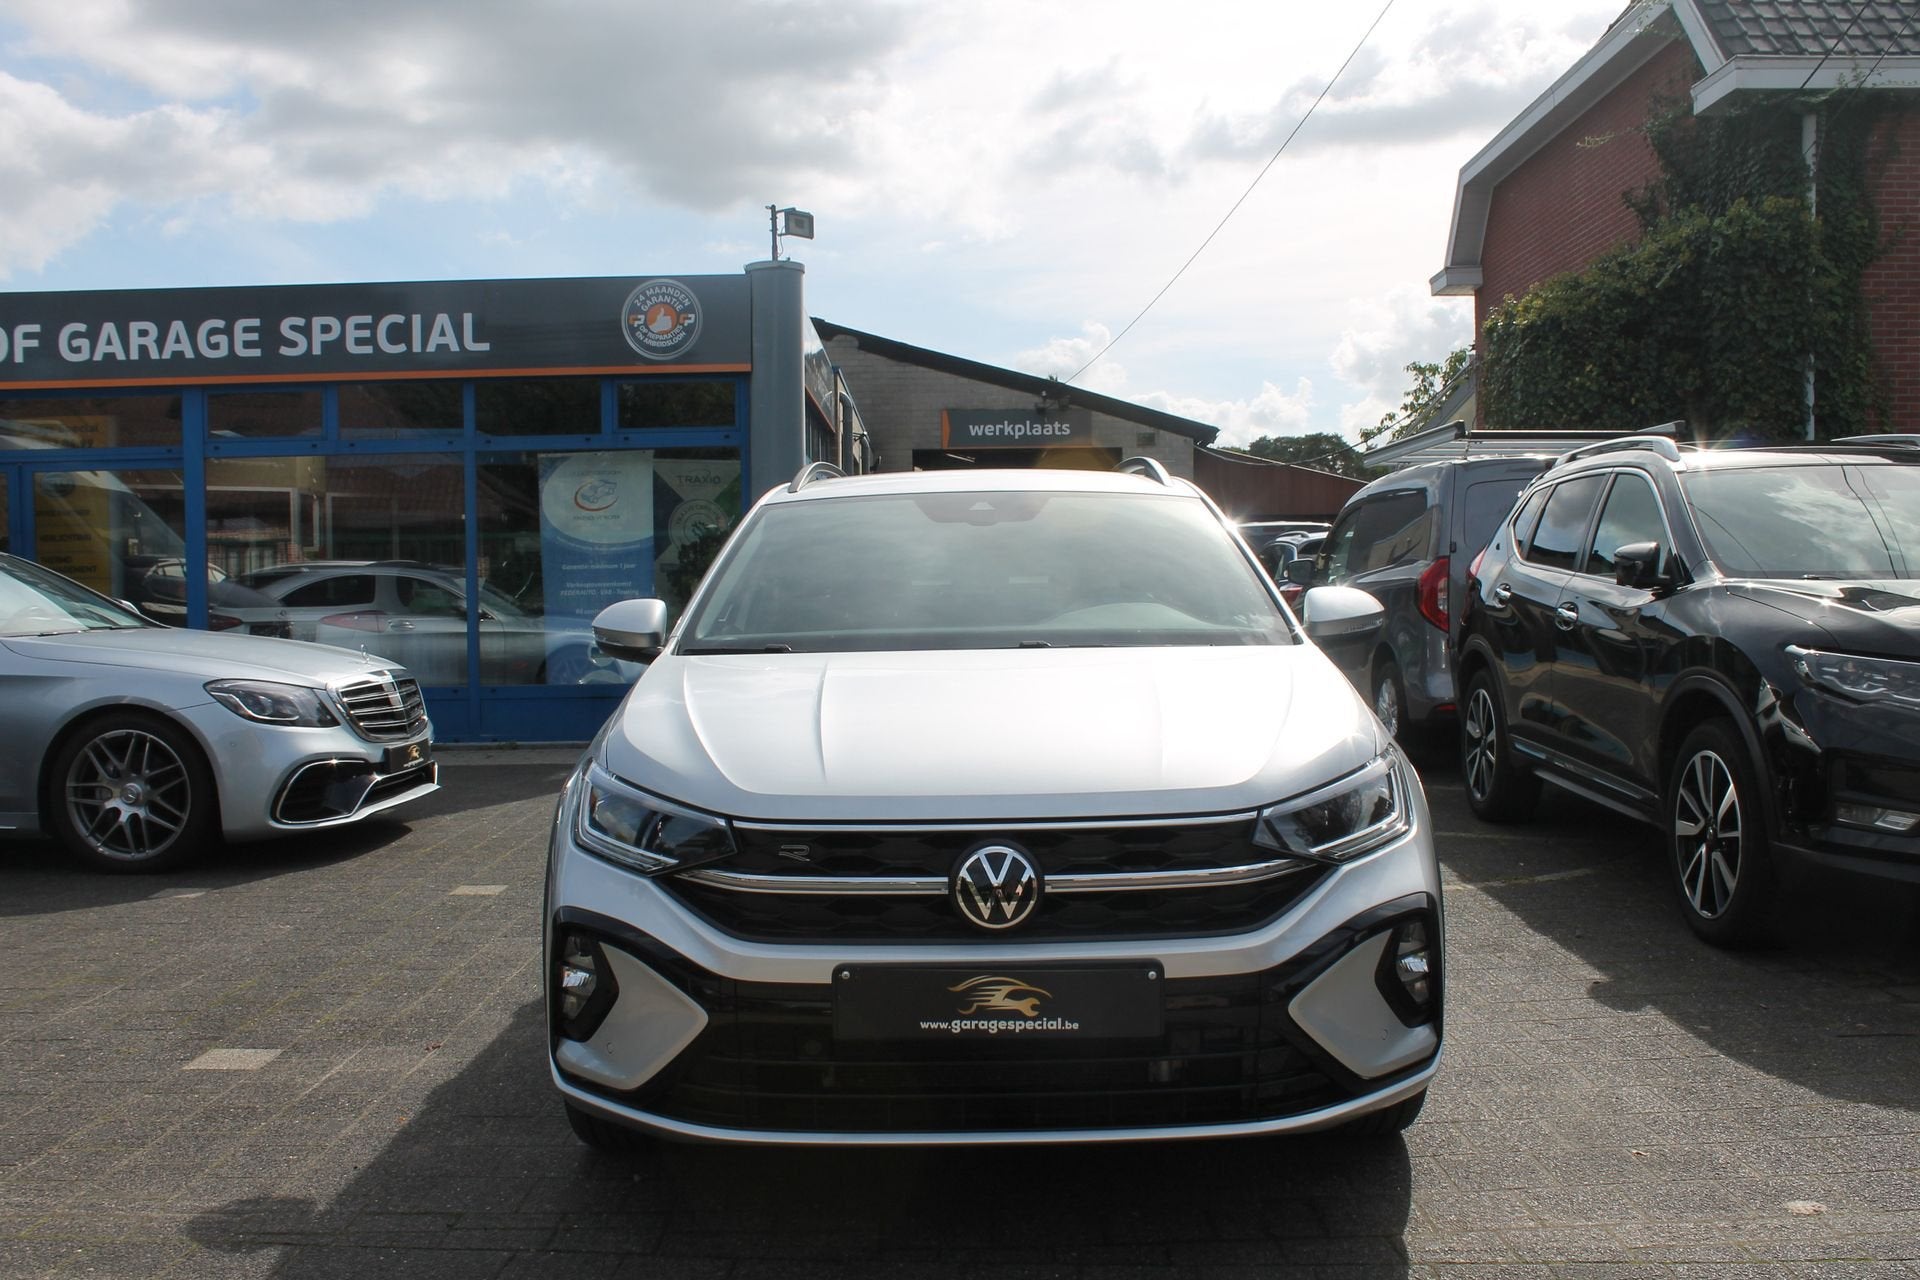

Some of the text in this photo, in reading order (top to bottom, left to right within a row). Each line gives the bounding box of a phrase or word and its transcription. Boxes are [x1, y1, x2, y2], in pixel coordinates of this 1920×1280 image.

[634, 286, 691, 307] 24 MAANDEN
[640, 295, 684, 312] GARANTIE
[58, 318, 262, 362] GARAGE
[278, 313, 490, 356] SPECIAL
[969, 420, 1071, 439] werkplaats
[920, 1017, 1079, 1033] www.garagespecial.be
